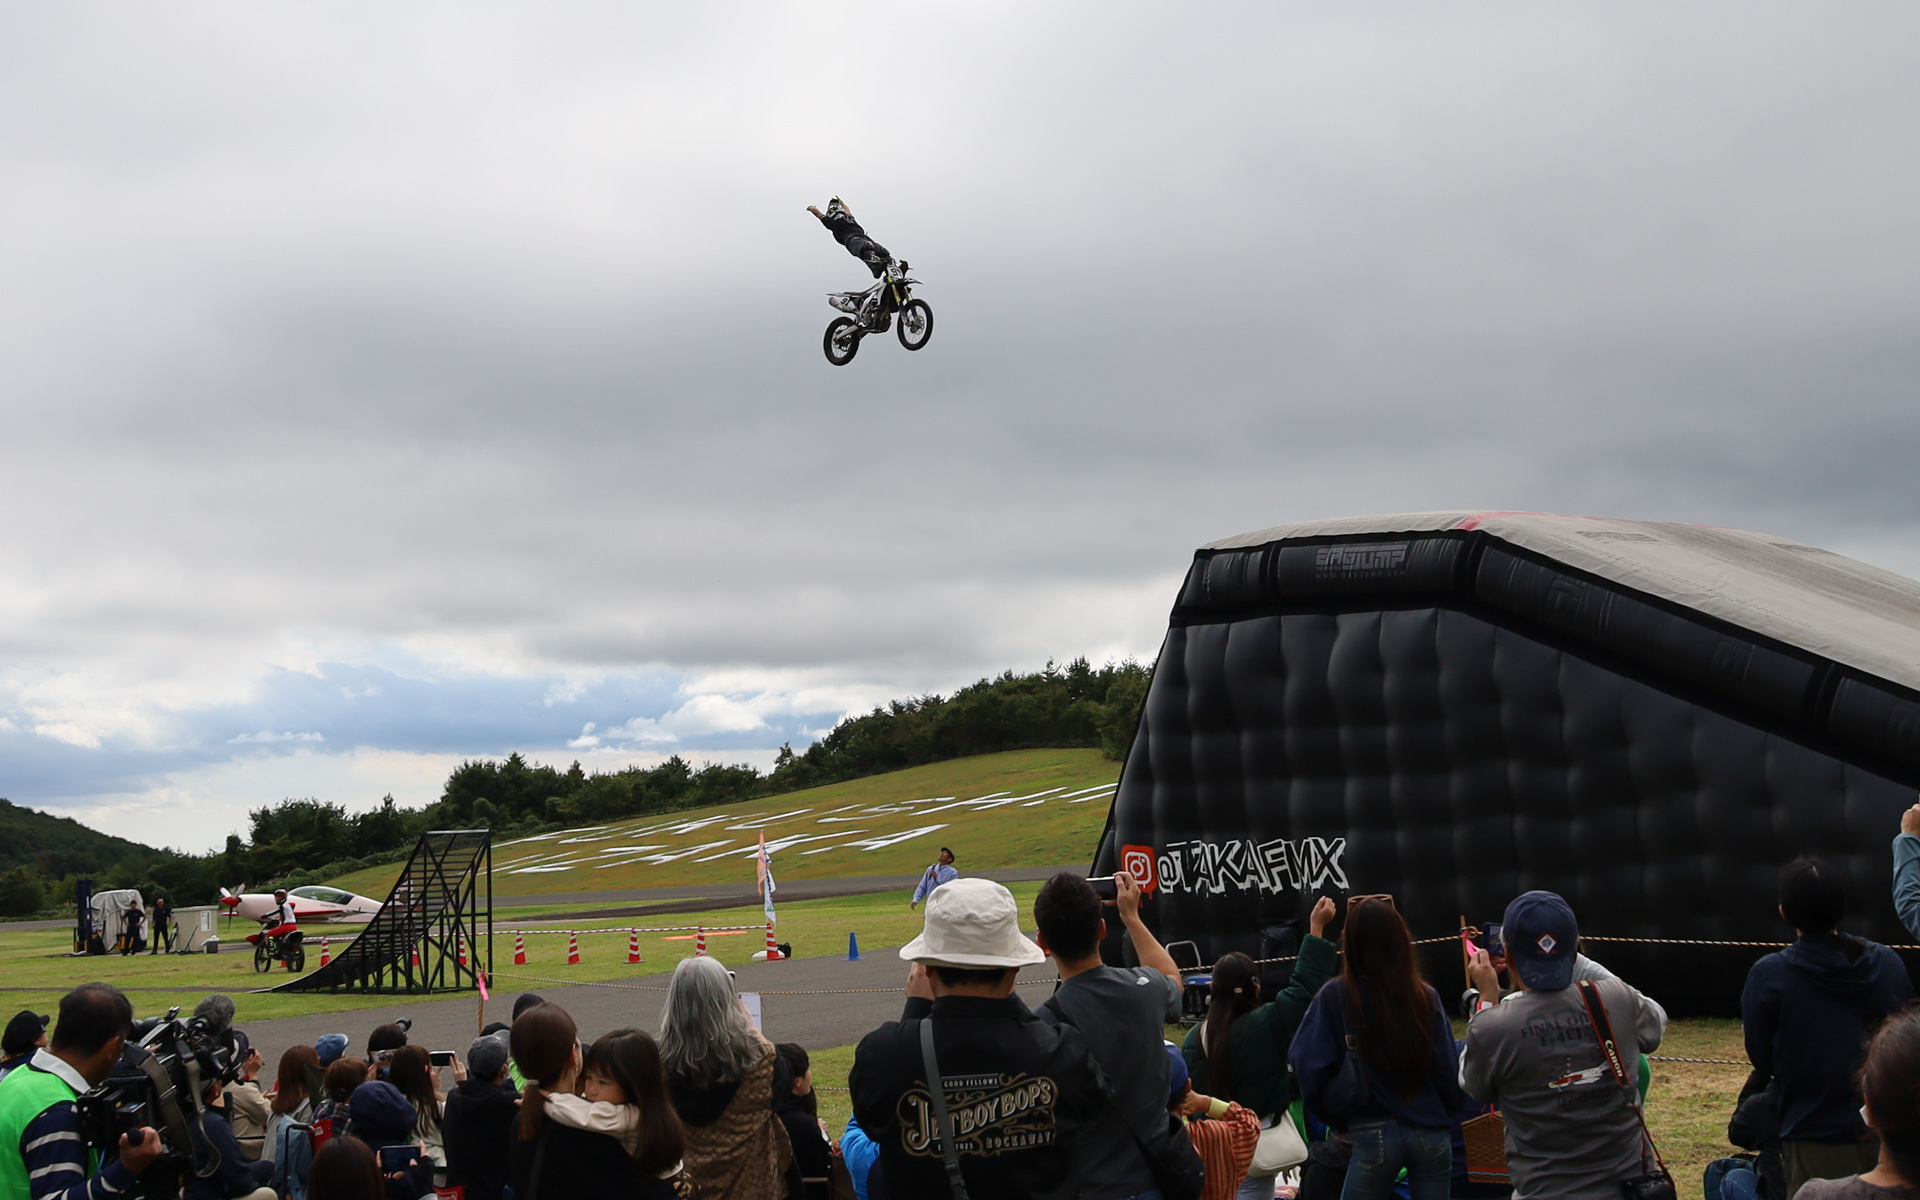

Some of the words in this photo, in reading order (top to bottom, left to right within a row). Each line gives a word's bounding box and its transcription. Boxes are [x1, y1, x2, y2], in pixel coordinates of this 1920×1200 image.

[490, 782, 1119, 850] FUKUSHI
[1521, 1020, 1563, 1038] FINAL
[1605, 1039, 1623, 1077] Canon
[943, 1079, 964, 1088] GOOD
[965, 1077, 998, 1087] FELLOWS
[986, 1131, 1051, 1150] ROCKAWAY
